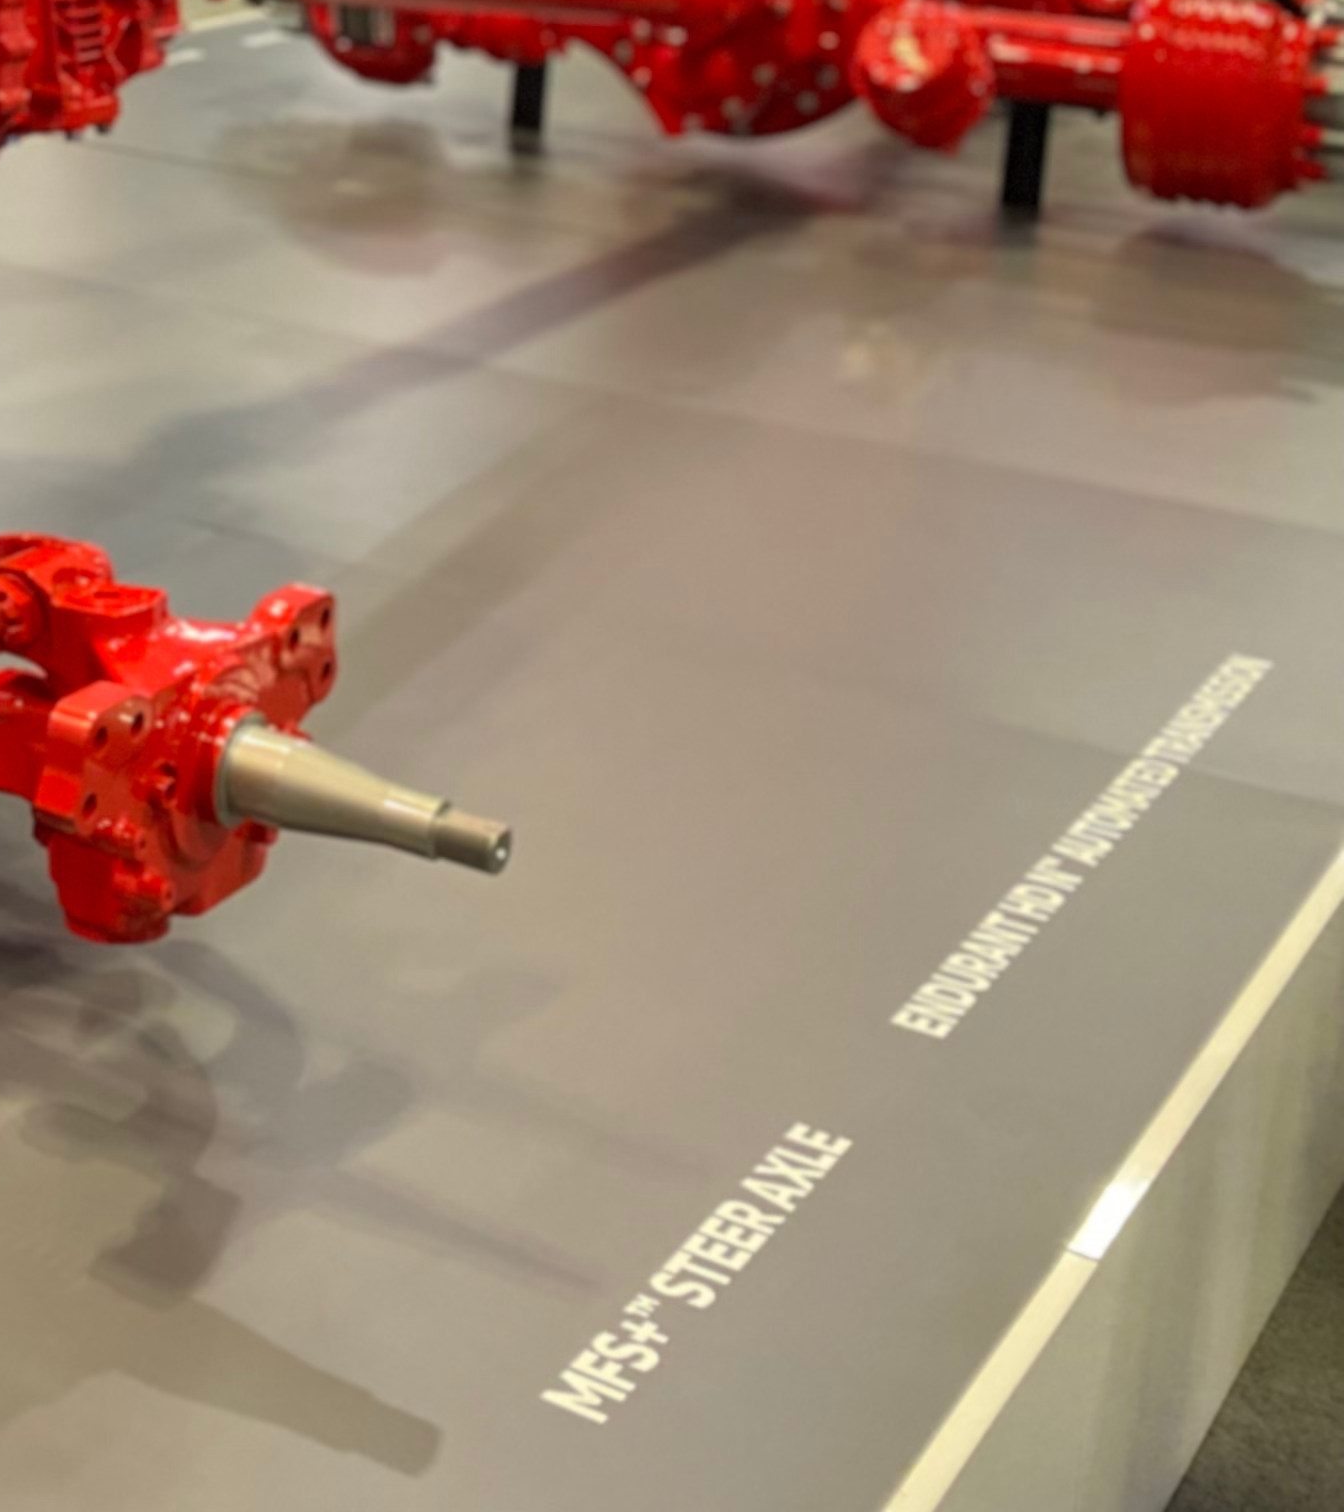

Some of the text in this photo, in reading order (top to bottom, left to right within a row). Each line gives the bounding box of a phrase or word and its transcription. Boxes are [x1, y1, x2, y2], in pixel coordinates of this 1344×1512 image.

[889, 909, 1040, 1040] ENDURANT
[1050, 758, 1180, 868] AUTOMATED
[648, 1198, 787, 1310] STEER
[739, 1120, 853, 1214] AXLE
